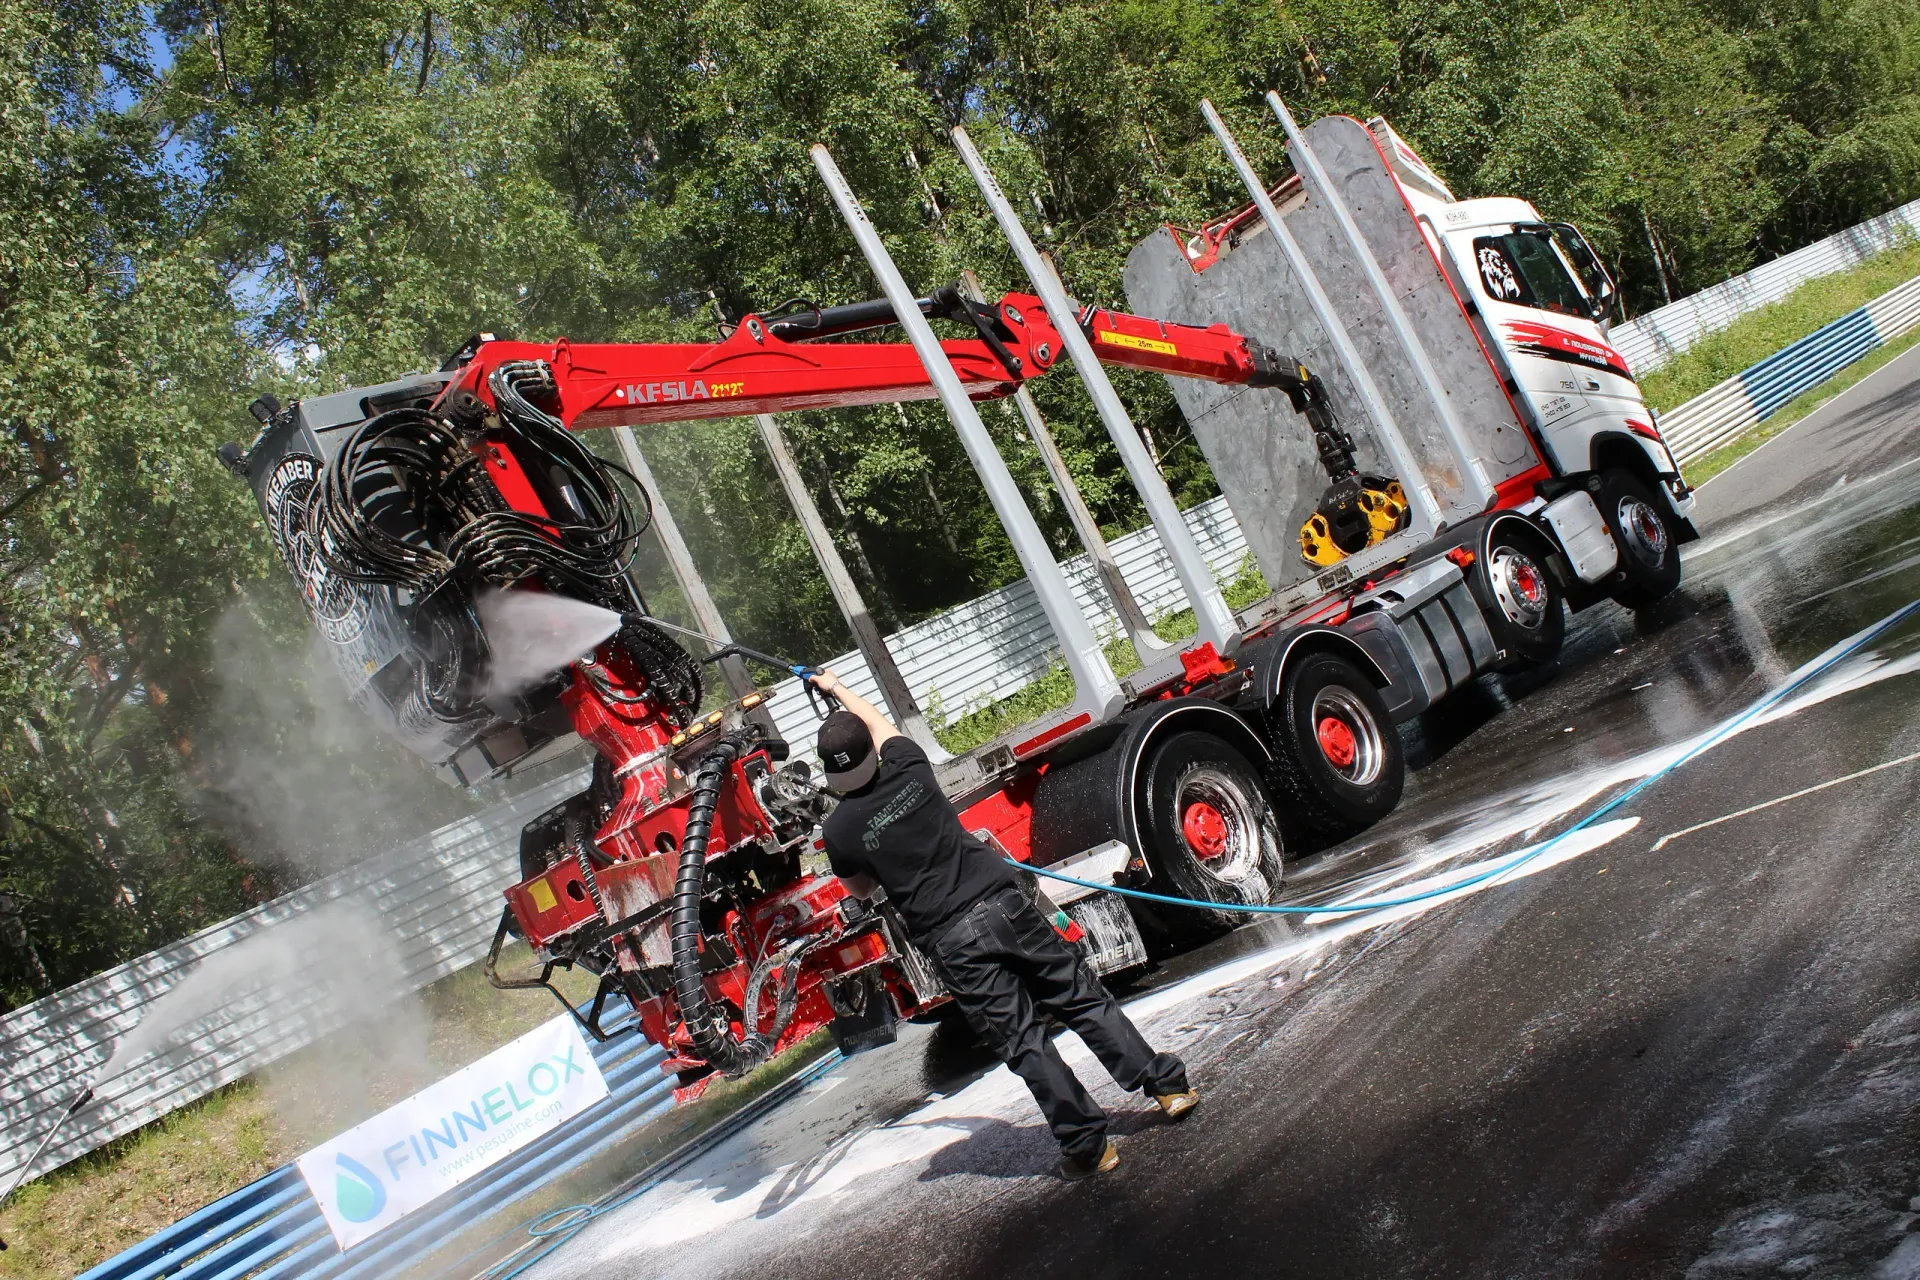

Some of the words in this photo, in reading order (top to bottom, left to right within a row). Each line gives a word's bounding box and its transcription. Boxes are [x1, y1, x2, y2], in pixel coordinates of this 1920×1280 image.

[1138, 340, 1153, 348] 25m
[626, 380, 711, 404] KESLA
[1560, 381, 1574, 389] 750
[268, 459, 313, 511] MEMBER
[867, 779, 919, 829] TAMPEREEN
[383, 1045, 585, 1181] FINNELOX
[438, 1099, 563, 1178] www.pesuaine.com
